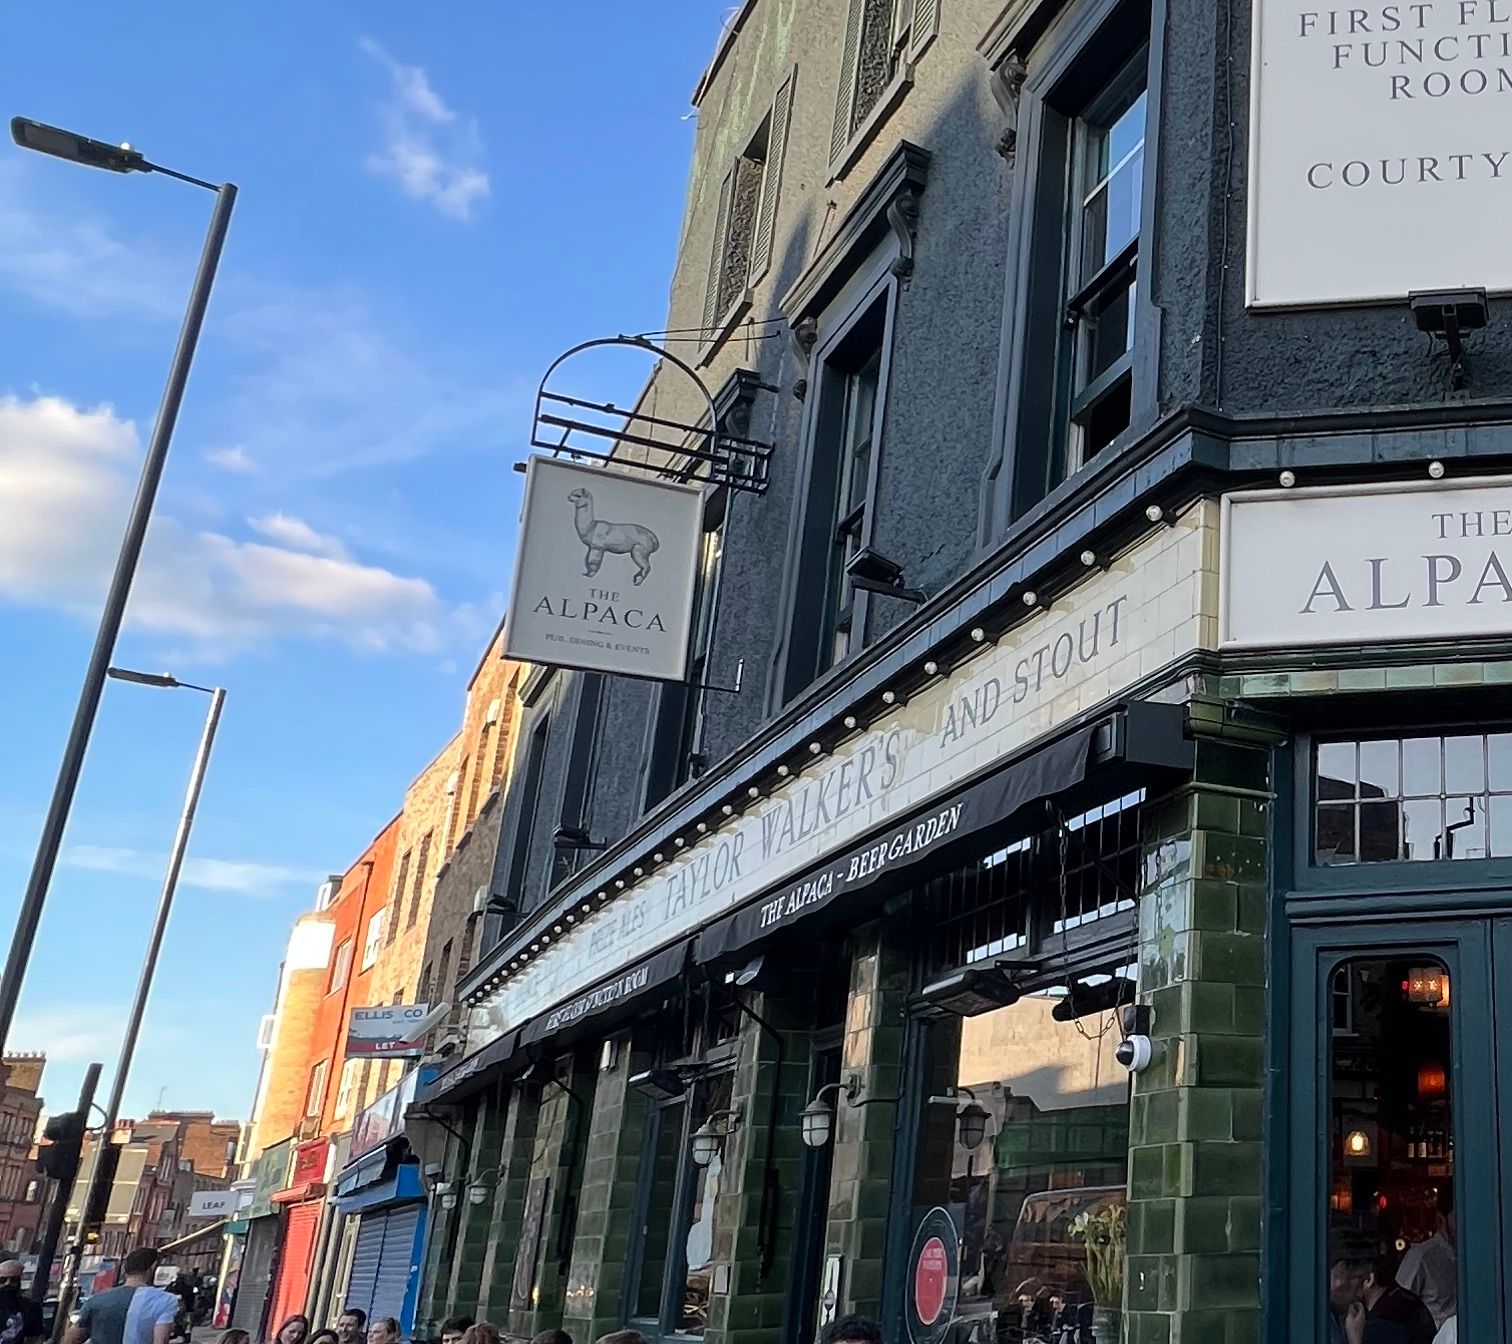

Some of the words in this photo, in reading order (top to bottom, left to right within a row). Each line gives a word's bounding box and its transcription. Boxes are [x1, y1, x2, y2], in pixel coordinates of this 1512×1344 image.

[1298, 3, 1436, 38] FIRST
[588, 588, 620, 603] THE
[532, 596, 667, 633] ALPACA
[664, 830, 744, 921] TAYLOR
[761, 729, 901, 862] WALKER'S
[940, 677, 1001, 748] AND
[1013, 595, 1128, 704] STOUT
[760, 895, 787, 928] THE
[785, 870, 834, 916] ALPACA
[845, 841, 889, 883] BEER
[888, 802, 965, 861] GARDEN
[354, 1009, 394, 1021] ELLIS
[404, 1008, 423, 1018] CO
[375, 1040, 397, 1051] LET
[201, 1200, 226, 1210] LEAF
